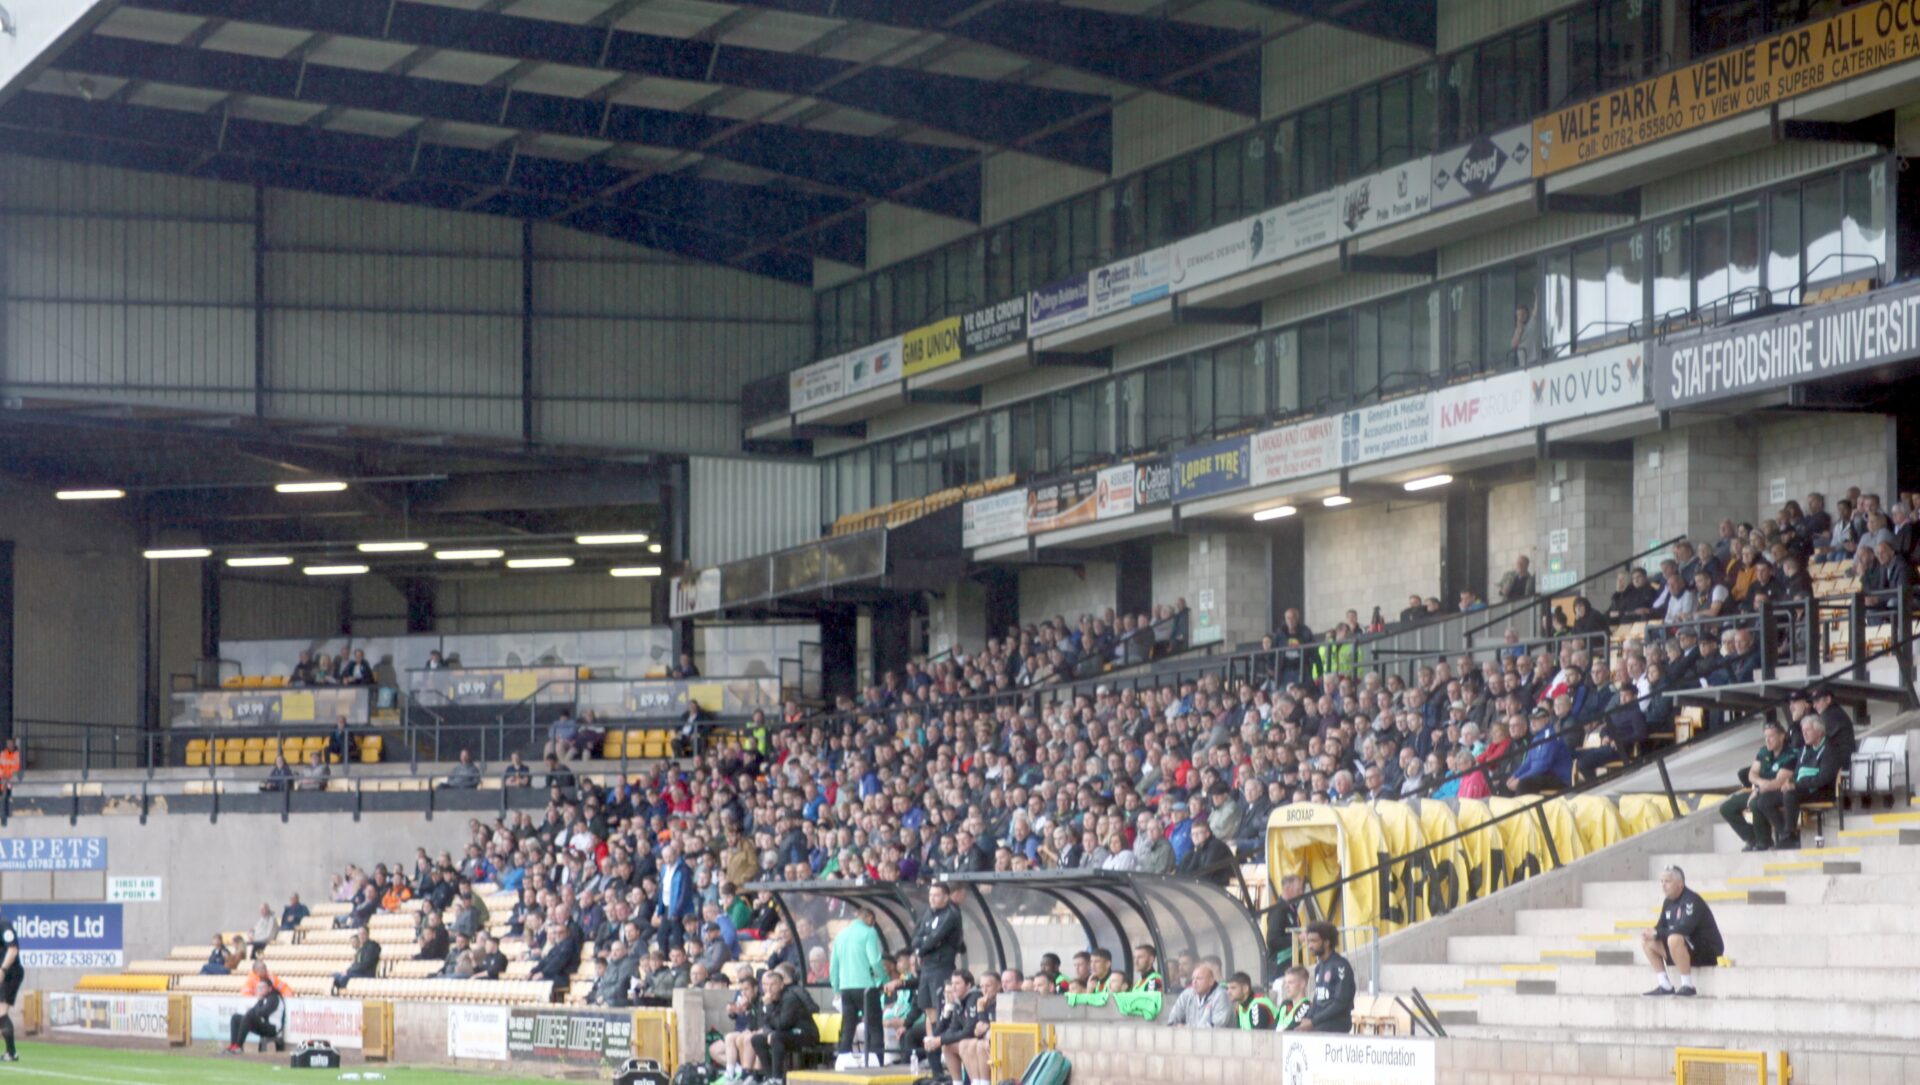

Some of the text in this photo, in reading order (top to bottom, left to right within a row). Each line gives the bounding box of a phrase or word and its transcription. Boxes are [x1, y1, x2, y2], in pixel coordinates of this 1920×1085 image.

[1559, 0, 1920, 144] VALE PARK A VENUE FOR ALL OCC
[1690, 102, 1706, 123] TO
[1711, 91, 1741, 116] VIEW
[1746, 82, 1771, 105] OUR
[1777, 64, 1825, 97] SUPERB
[1832, 40, 1896, 78] CATERING
[1461, 149, 1498, 184] Sneyd
[1629, 232, 1644, 261] 16
[1656, 226, 1672, 254] 15
[903, 341, 924, 366] GMB
[927, 323, 961, 358] UNION
[1671, 320, 1814, 400] STAFFORDSHIRE
[1549, 362, 1622, 406] NOVUS
[1181, 455, 1212, 487] LODGE
[1215, 450, 1239, 475] TYRE
[115, 879, 155, 889] FIRST AID
[122, 890, 147, 899] POINT
[73, 915, 104, 938] Ltd
[72, 952, 116, 966] 538790
[1325, 1043, 1416, 1067] Port Vale Foundation
